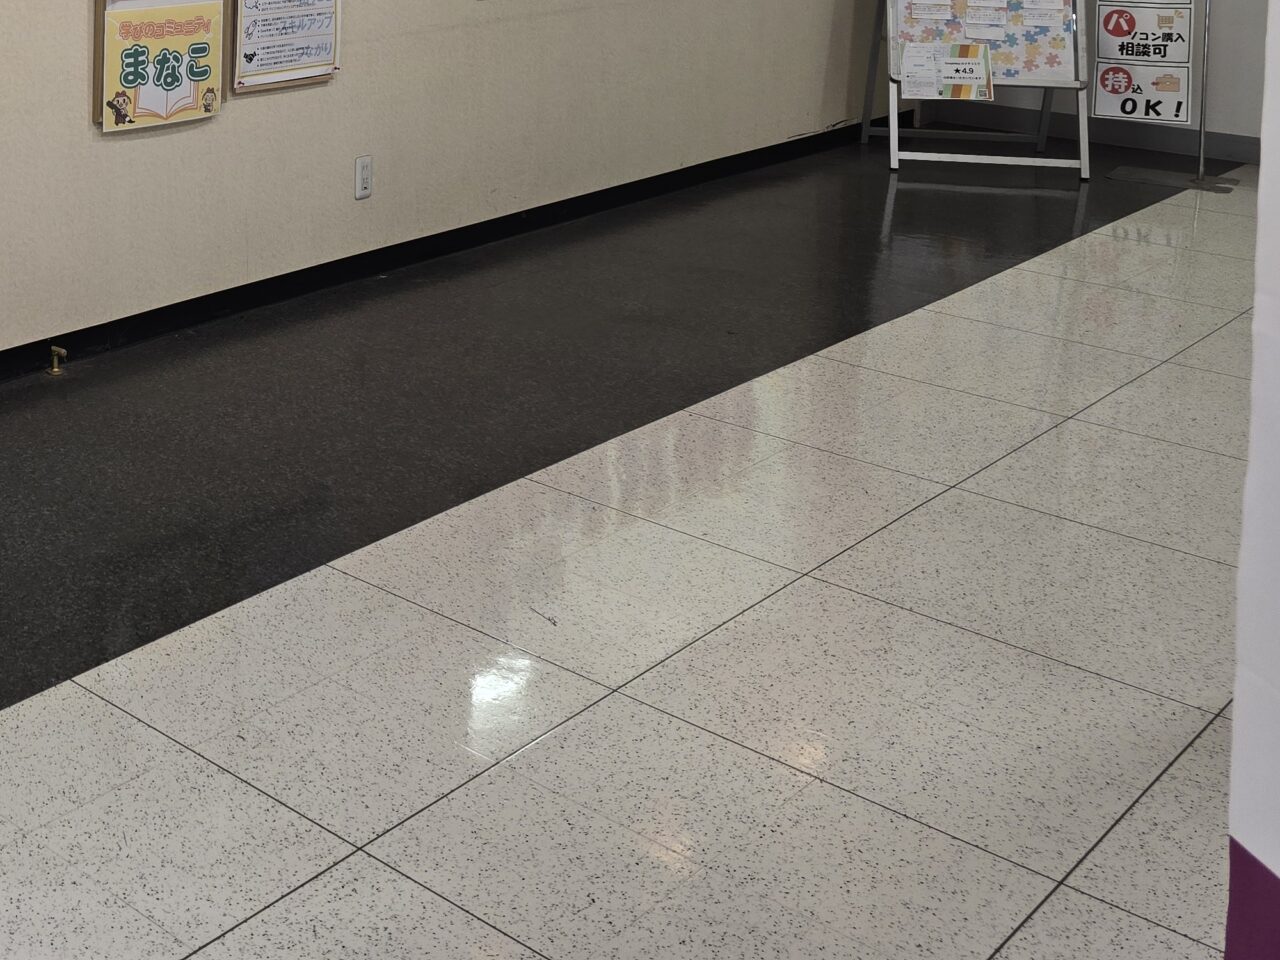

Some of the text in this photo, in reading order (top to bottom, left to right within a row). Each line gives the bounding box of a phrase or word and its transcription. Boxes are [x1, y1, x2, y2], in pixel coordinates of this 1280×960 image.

[118, 16, 212, 41] 学びのコミュニティ
[1118, 43, 1169, 58] 相談可
[120, 41, 212, 91] まなこ
